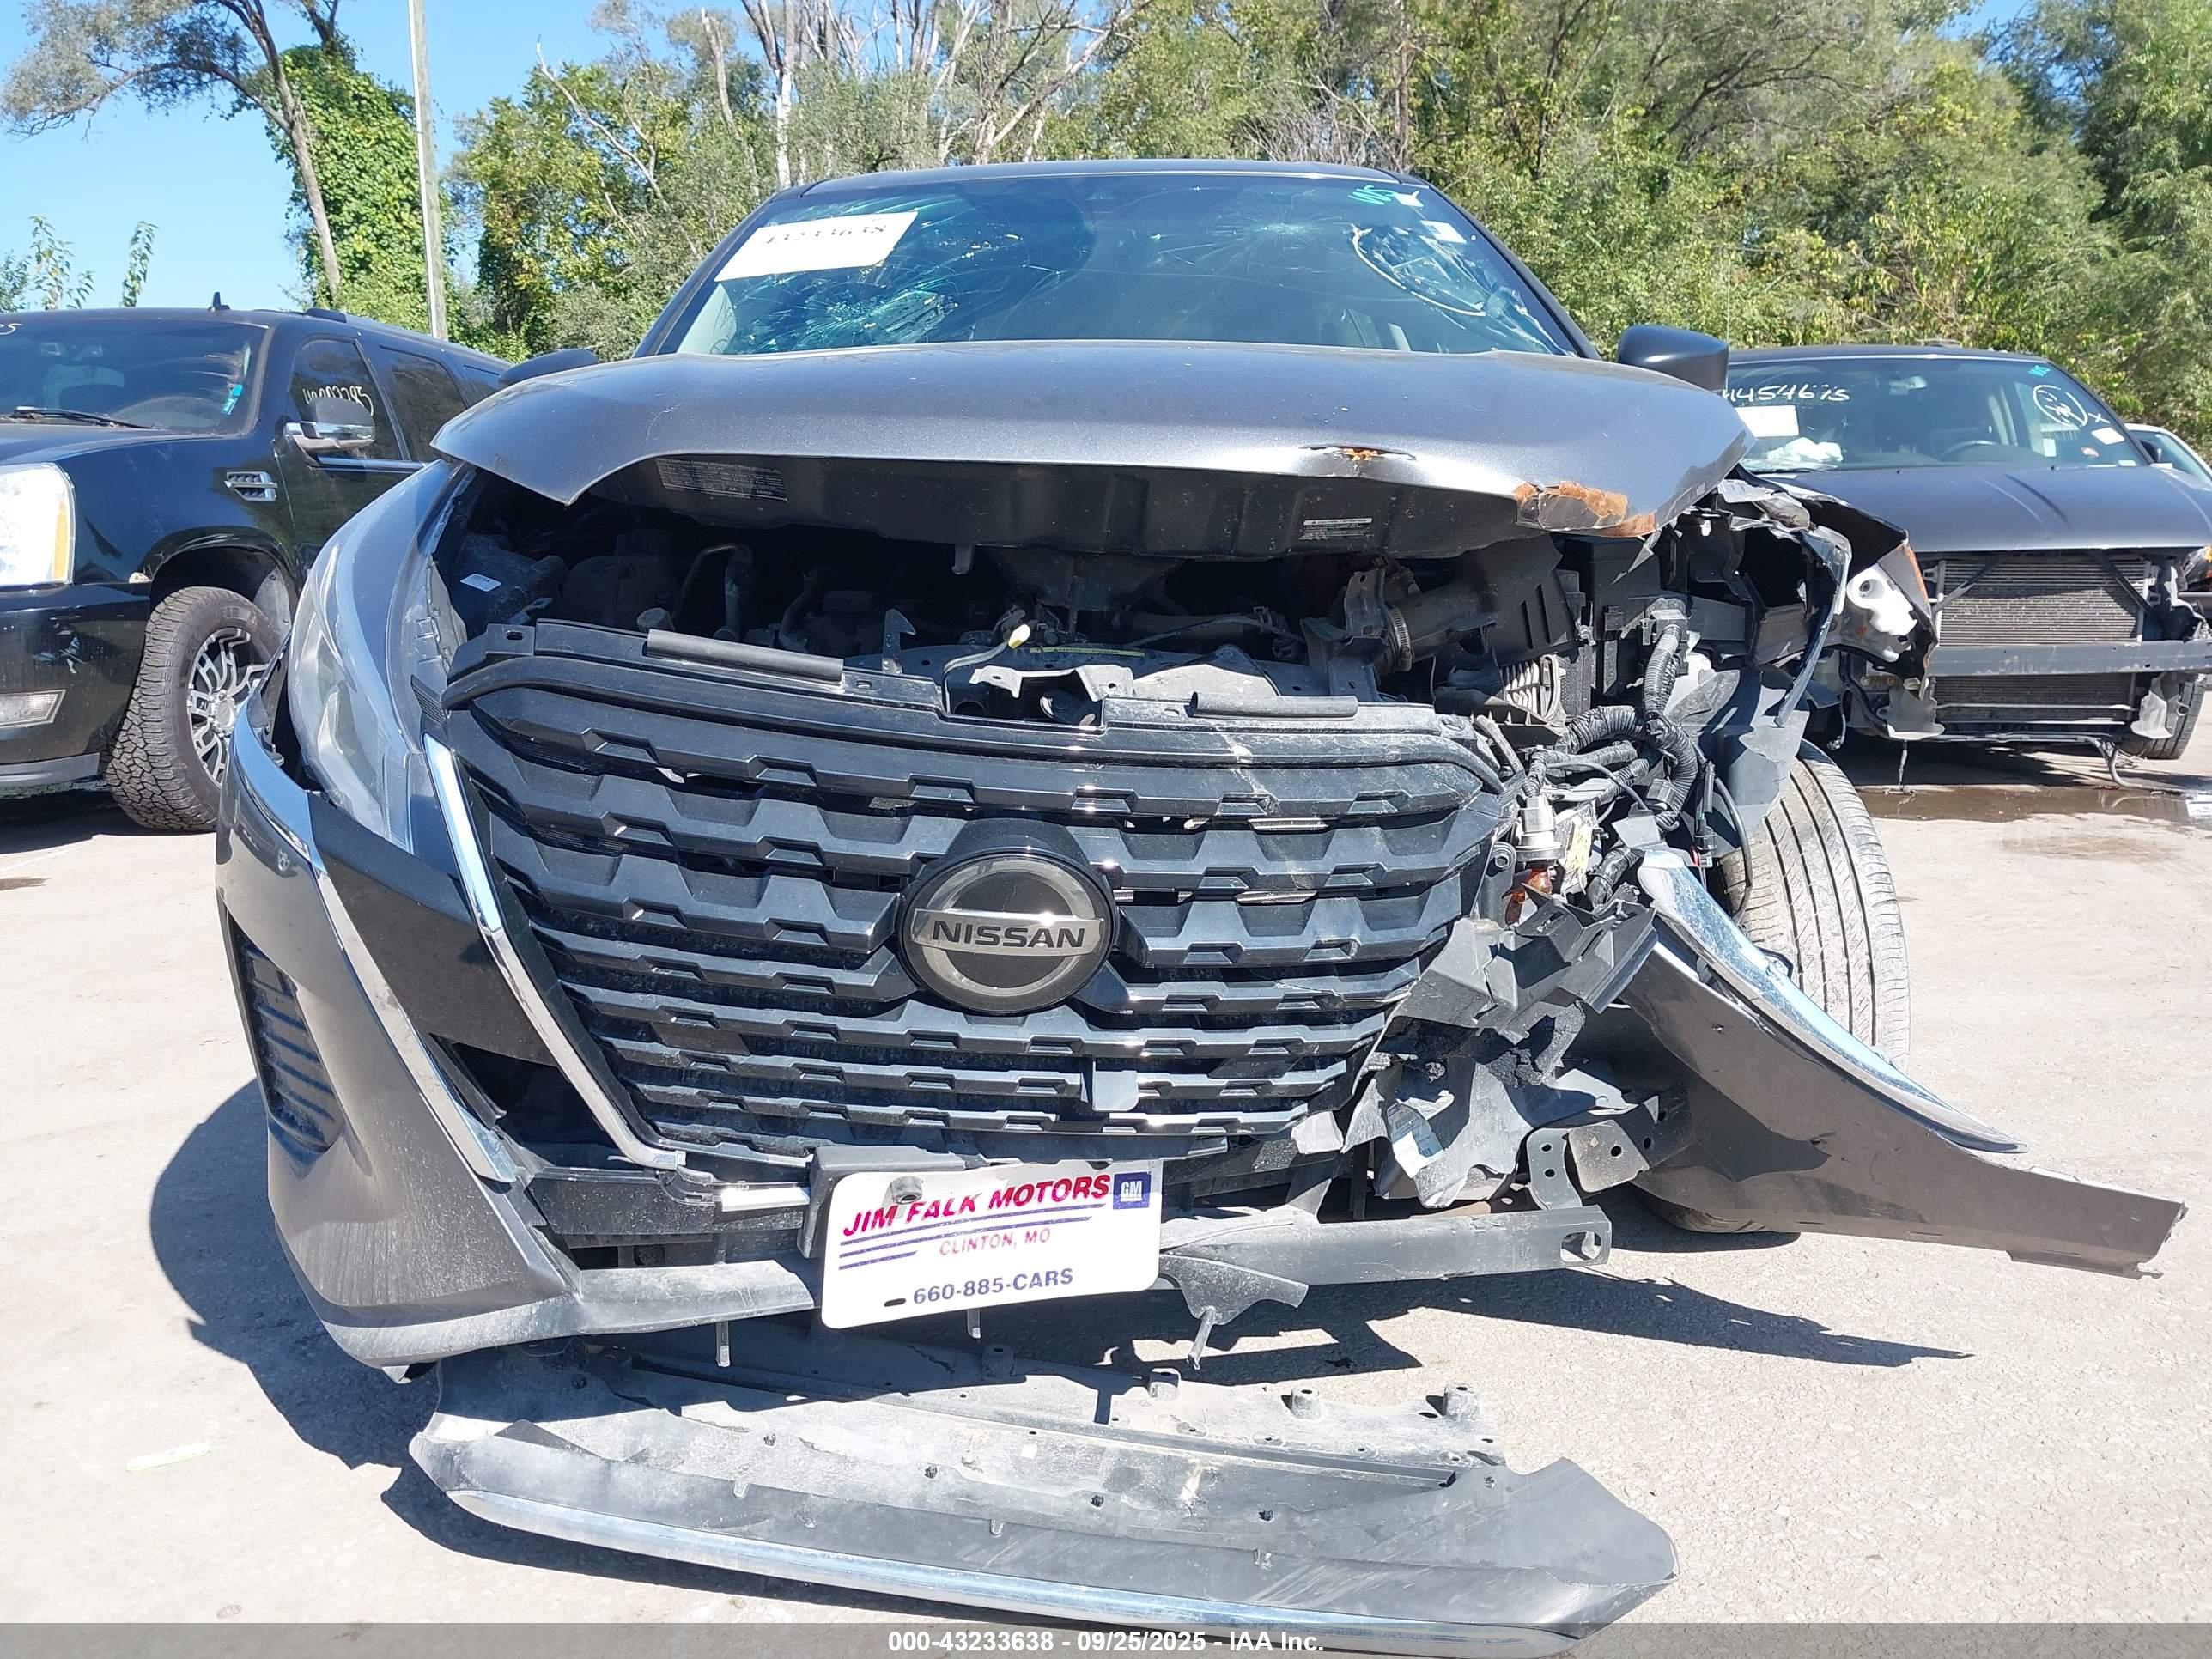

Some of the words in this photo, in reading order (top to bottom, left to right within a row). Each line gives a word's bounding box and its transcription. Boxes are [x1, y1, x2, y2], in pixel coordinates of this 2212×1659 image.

[932, 920, 1085, 948] NISSAN
[1120, 1180, 1143, 1200] GM
[842, 1204, 899, 1237] JIM
[906, 1192, 982, 1224] FALK
[988, 1174, 1111, 1209] MOTORS
[1024, 1227, 1051, 1244] MO
[913, 1267, 1074, 1304] 660-885-CARS
